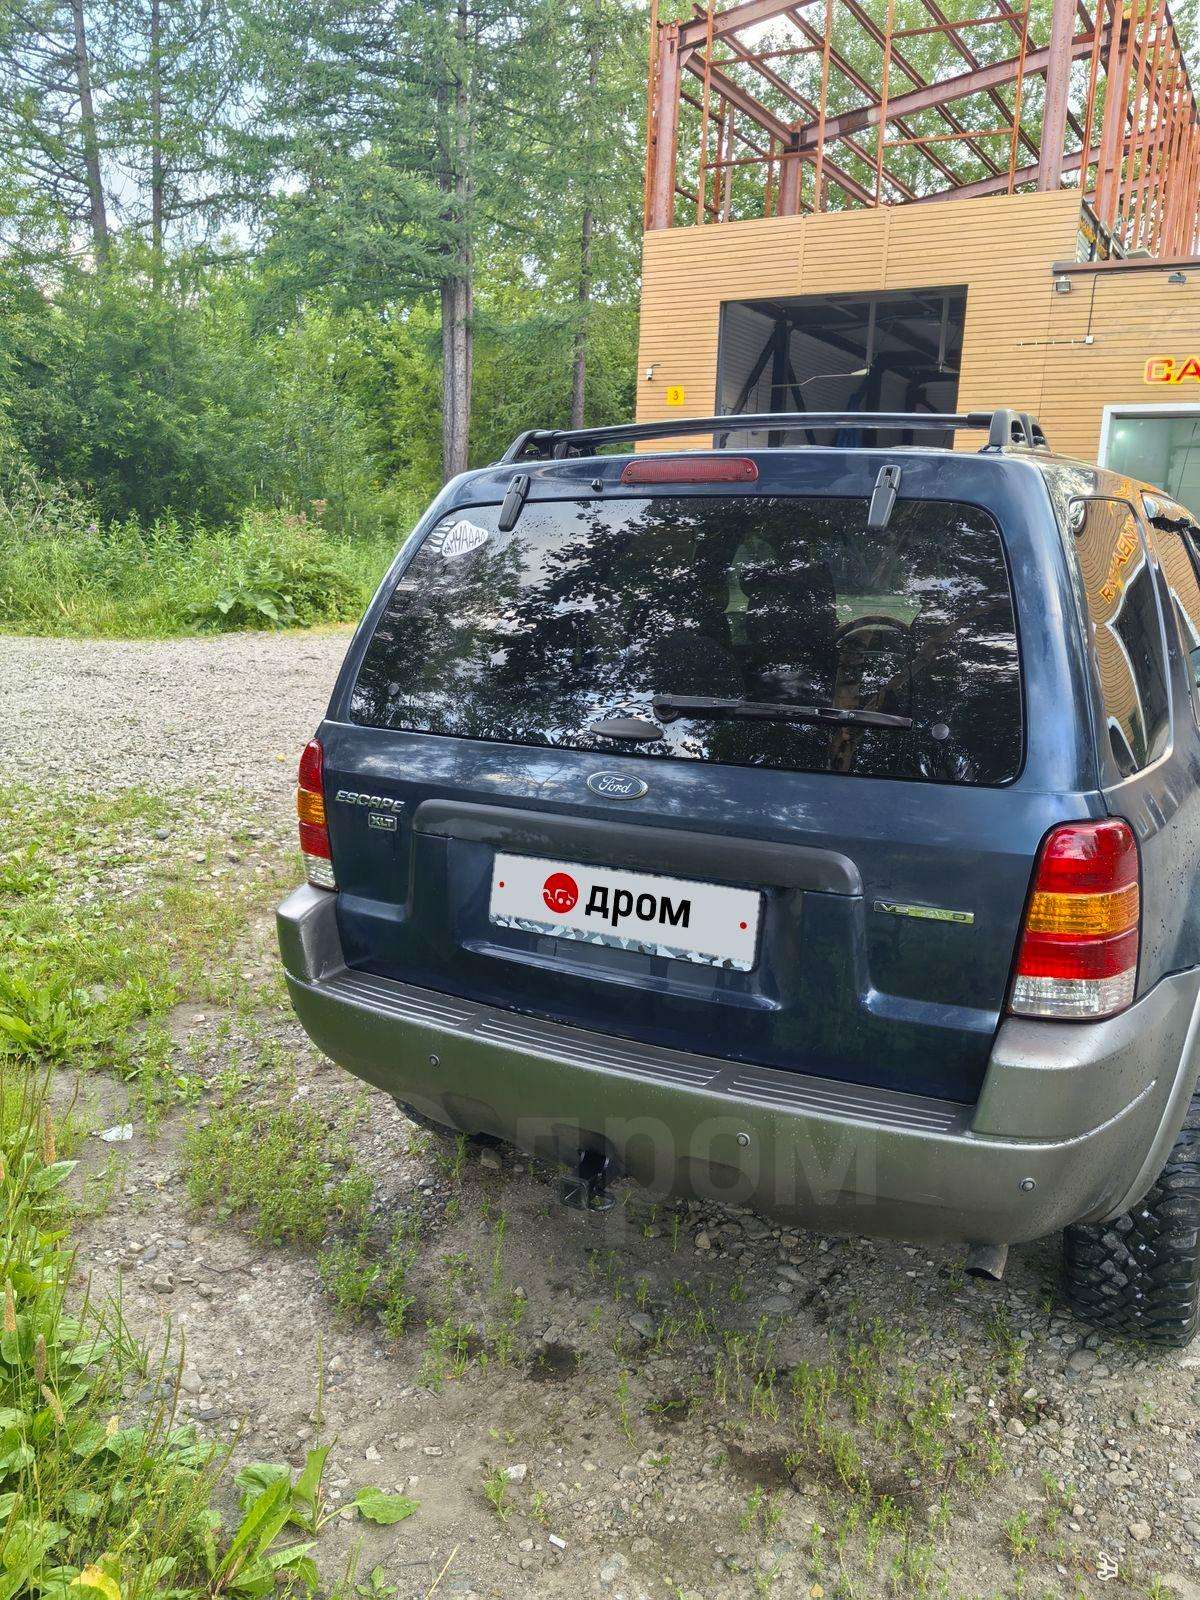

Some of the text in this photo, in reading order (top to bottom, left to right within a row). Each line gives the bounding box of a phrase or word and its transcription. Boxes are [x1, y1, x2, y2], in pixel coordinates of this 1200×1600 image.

[598, 775, 633, 794] Ford
[335, 789, 406, 814] ESCAPE
[370, 814, 395, 829] XLT
